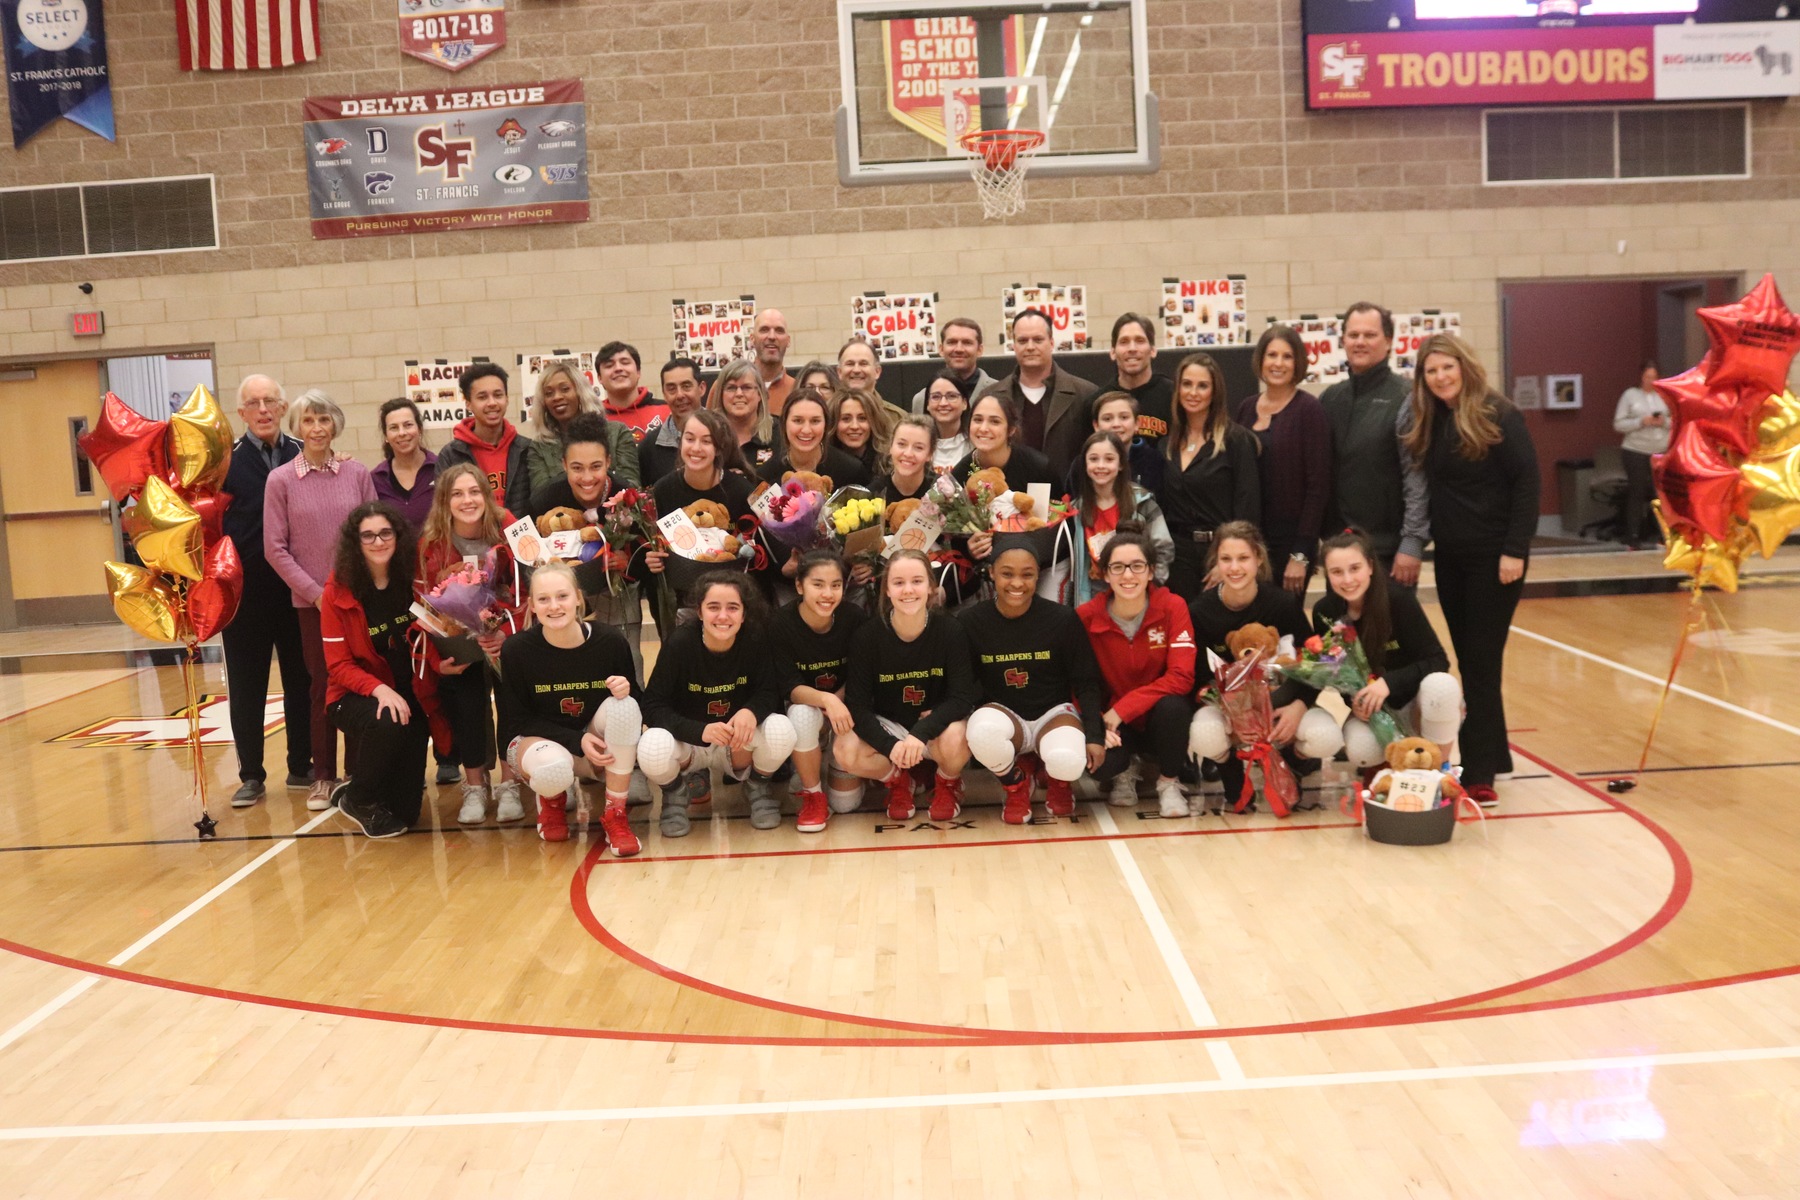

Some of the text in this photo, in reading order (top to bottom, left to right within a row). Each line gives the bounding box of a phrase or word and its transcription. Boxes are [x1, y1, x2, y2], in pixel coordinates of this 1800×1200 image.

[26, 9, 79, 25] SELECT
[412, 14, 494, 40] 2017-18
[914, 16, 975, 36] GIRL
[442, 42, 474, 59] SJS
[900, 37, 979, 60] SCHO
[10, 65, 106, 82] ST. FRANCIS CATHOLIC
[902, 63, 922, 78] OF
[926, 61, 960, 77] THE
[1321, 44, 1367, 88] SF
[1377, 47, 1649, 89] TROUBADOURS
[39, 81, 81, 92] 2017-2018
[341, 87, 545, 117] DELTA LEAGUE
[366, 127, 388, 155] D
[414, 124, 476, 182] SF
[547, 166, 577, 181] SJS
[416, 184, 480, 201] ST. FRANCIS
[346, 208, 553, 231] PURSUING VICTORY WITH HONOR
[74, 313, 98, 333] EXIT
[688, 318, 741, 338] Lauren
[866, 309, 917, 336] Gabi
[1395, 335, 1428, 355] Jo
[421, 365, 473, 381] RACH
[511, 522, 529, 538] #42
[663, 514, 682, 529] #20
[554, 540, 567, 550] SF
[995, 652, 1032, 662] SHARPENS
[1034, 650, 1050, 660] IRON
[879, 673, 894, 683] IRON
[895, 671, 929, 681] SHARPENS
[534, 684, 551, 693] IRON
[553, 681, 590, 692] SHARPENS
[1399, 781, 1427, 793] #23
[874, 820, 977, 834] PAX
